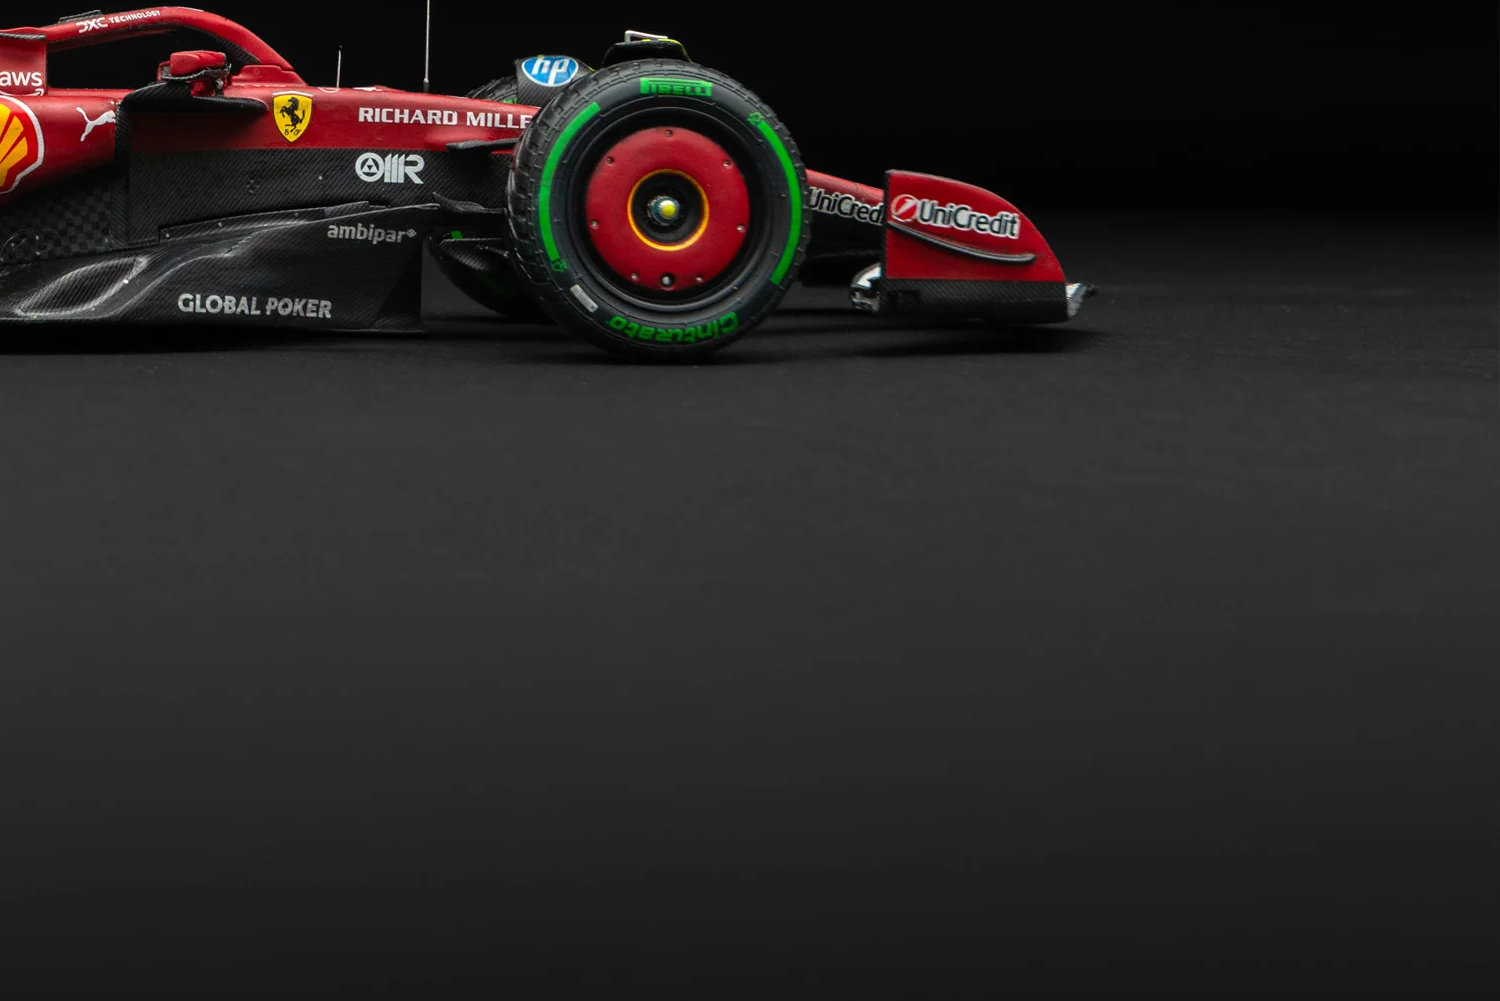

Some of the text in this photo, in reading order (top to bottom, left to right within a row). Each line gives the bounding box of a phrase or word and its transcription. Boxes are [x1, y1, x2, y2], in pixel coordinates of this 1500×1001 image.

[108, 10, 161, 24] TECHNOLOGY
[531, 57, 569, 86] hp
[639, 77, 713, 97] PIRELLI
[358, 107, 458, 125] RICHARD
[919, 202, 1018, 237] UniCredit
[327, 223, 406, 244] ambipar
[177, 293, 333, 319] GLOBAL POKER
[608, 311, 739, 342] Cinturato
